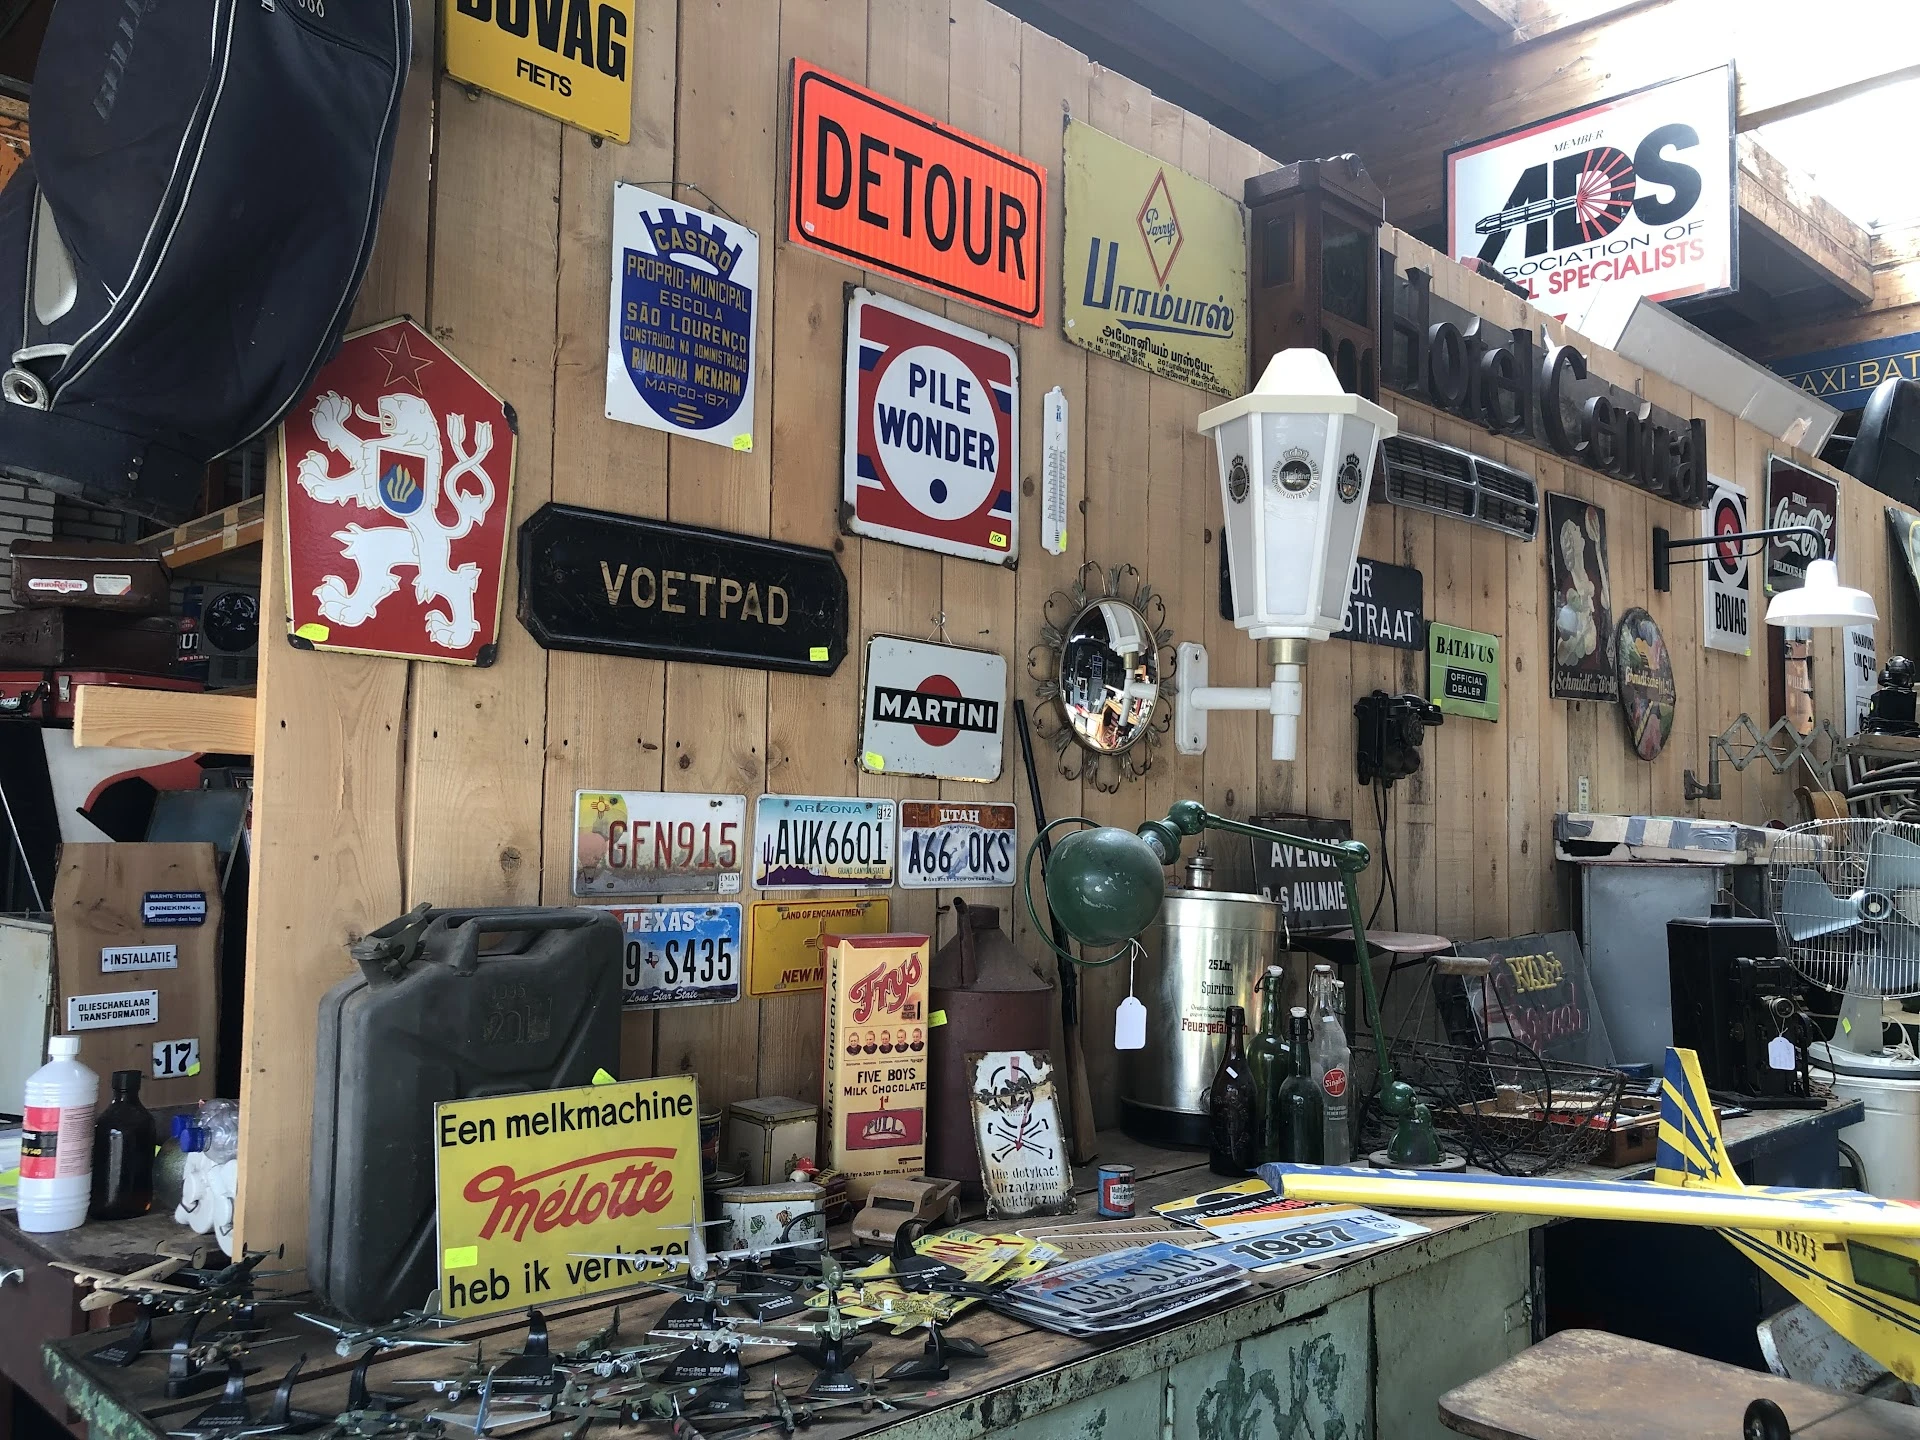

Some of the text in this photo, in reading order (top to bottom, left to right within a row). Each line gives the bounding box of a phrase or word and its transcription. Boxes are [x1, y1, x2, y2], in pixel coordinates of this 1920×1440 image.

[516, 57, 573, 98] FIETS
[1552, 129, 1605, 154] MEMBER
[816, 115, 1027, 281] DETOUR
[1477, 123, 1702, 266] ADS
[1664, 219, 1705, 241] OF
[654, 227, 732, 272] CASTRO
[627, 254, 748, 313] PROPRIO-MUNICIPAL
[1549, 239, 1705, 295] SPECIALISTS
[660, 289, 723, 323] ESCOLA
[623, 325, 675, 351] CONSTRUÍDA
[680, 339, 690, 355] NA
[627, 301, 747, 354] SÃO LOURENÇO
[1379, 247, 1536, 440] Hotel
[631, 347, 741, 397] RIVADAVIA MENARIM
[909, 362, 971, 415] PILE
[645, 377, 729, 410] MARÇO-1971
[877, 402, 995, 473] WONDER
[600, 560, 789, 626] VOETPAD
[1350, 562, 1373, 598] OR
[1343, 601, 1414, 643] STRAAT
[1715, 591, 1747, 636] BOVAG
[1435, 635, 1495, 664] BATAVUS
[1450, 672, 1483, 687] OFFICIAL
[1862, 654, 1869, 682] 6
[1451, 684, 1481, 697] DEALER
[879, 692, 994, 729] MARTINI
[794, 804, 862, 815] ARIZONA
[939, 809, 979, 823] UTAH
[608, 820, 738, 869] GFN915
[775, 819, 887, 865] AVK6601
[908, 830, 951, 874] A66
[837, 867, 853, 875] GRAND
[1293, 881, 1348, 912] AULNAIE
[623, 911, 695, 933] TEXAS
[781, 908, 866, 921] LAND OF ENCHANTMENT
[110, 951, 171, 965] INSTALLATIE
[664, 937, 732, 985] S435
[1208, 959, 1218, 970] 25
[781, 968, 812, 984] NEW
[78, 998, 150, 1012] OLIESCHAKELAAR
[626, 987, 699, 1003] Lone Star State
[79, 1008, 150, 1022] TRANSFORMATOR
[828, 957, 838, 1070] CHOCOLATE
[162, 1043, 192, 1075] 17
[857, 1067, 916, 1084] FIVE BOYS
[844, 1081, 927, 1097] MILK CHOCOLATE
[441, 1090, 693, 1148] Een melkmachine
[991, 1168, 1009, 1180] Nie
[1181, 1213, 1207, 1221] New
[1206, 1200, 1263, 1216] Convenient
[1230, 1222, 1357, 1262] 1987
[450, 1268, 510, 1309] heb
[525, 1260, 551, 1294] ik
[1058, 1257, 1137, 1281] TEXAS
